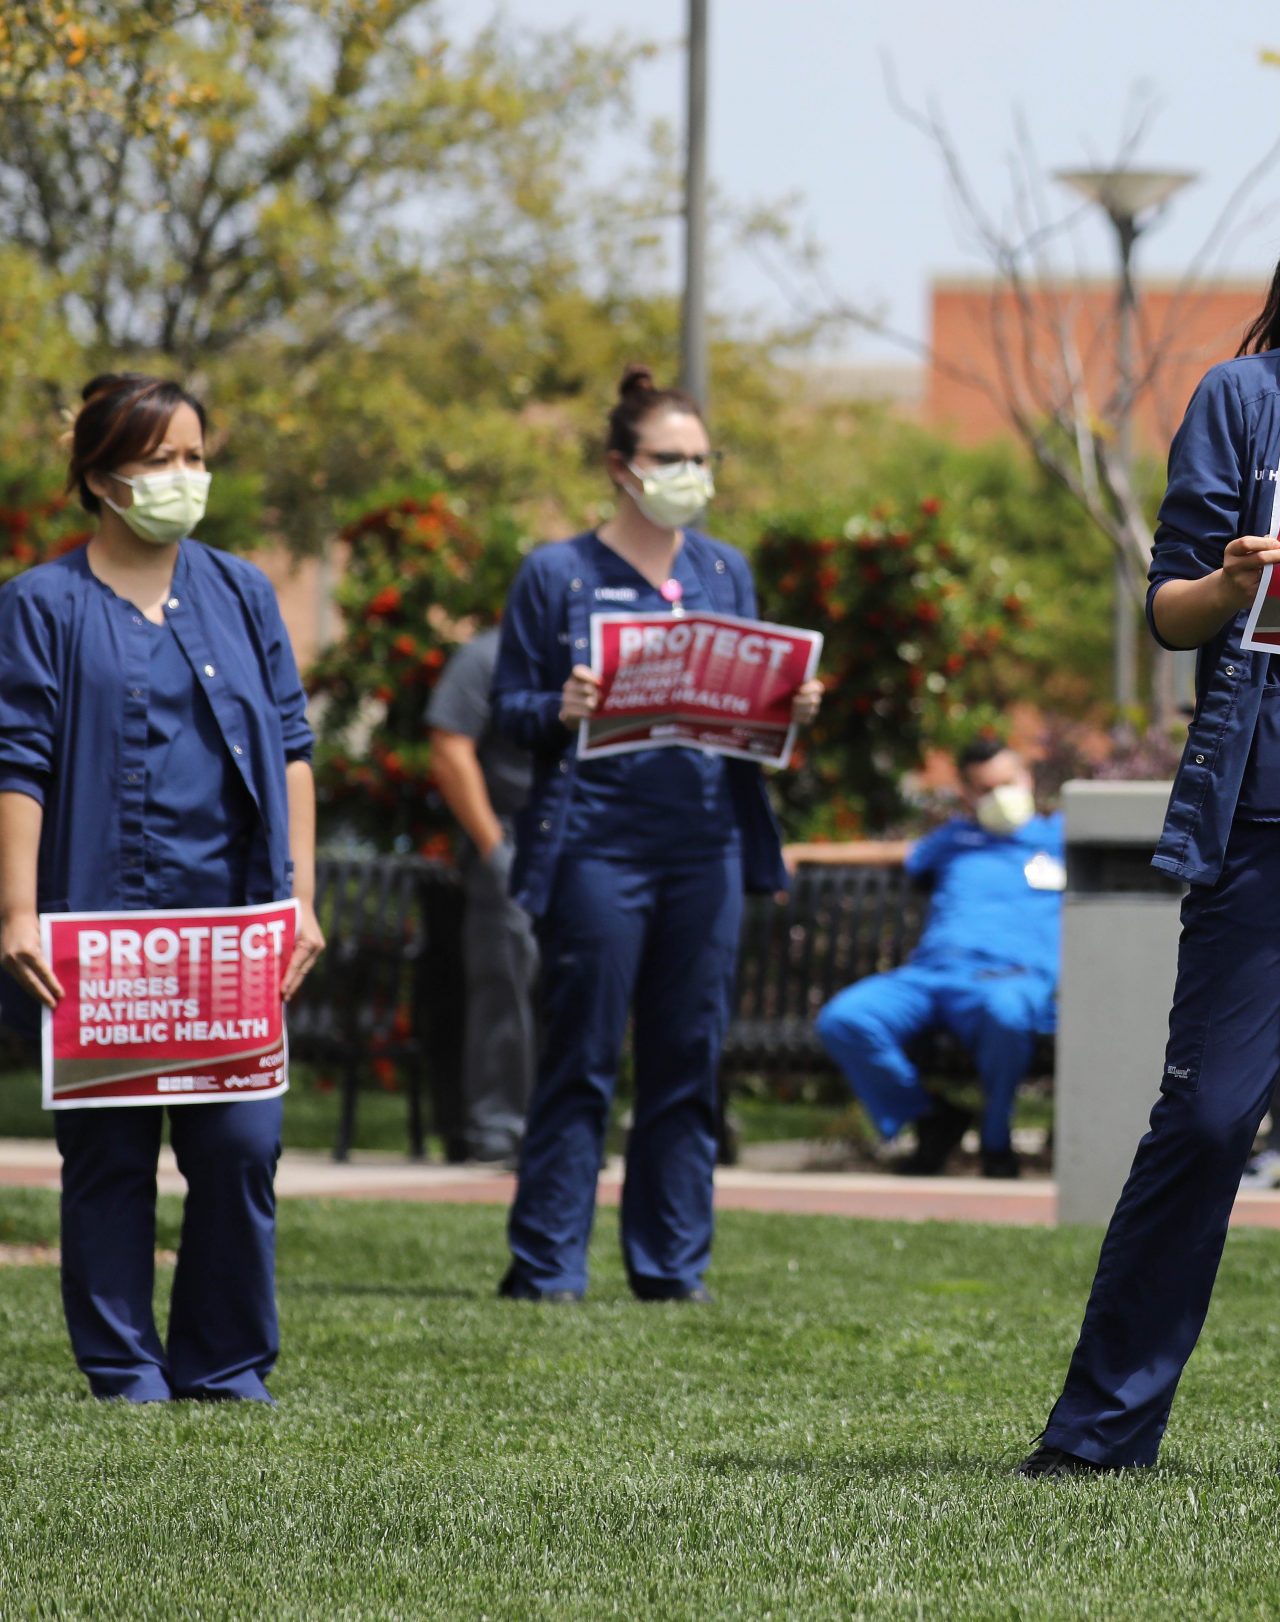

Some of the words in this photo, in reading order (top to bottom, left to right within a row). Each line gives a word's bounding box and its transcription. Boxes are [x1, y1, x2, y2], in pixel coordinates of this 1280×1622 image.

[619, 622, 794, 672] PROTECT
[671, 688, 750, 715] HEALTH
[78, 920, 286, 967] PROTECT
[79, 976, 180, 999] NURSES
[79, 998, 200, 1023] PATIENTS
[79, 1021, 169, 1046] PUBLIC
[174, 1017, 269, 1042] HEALTH
